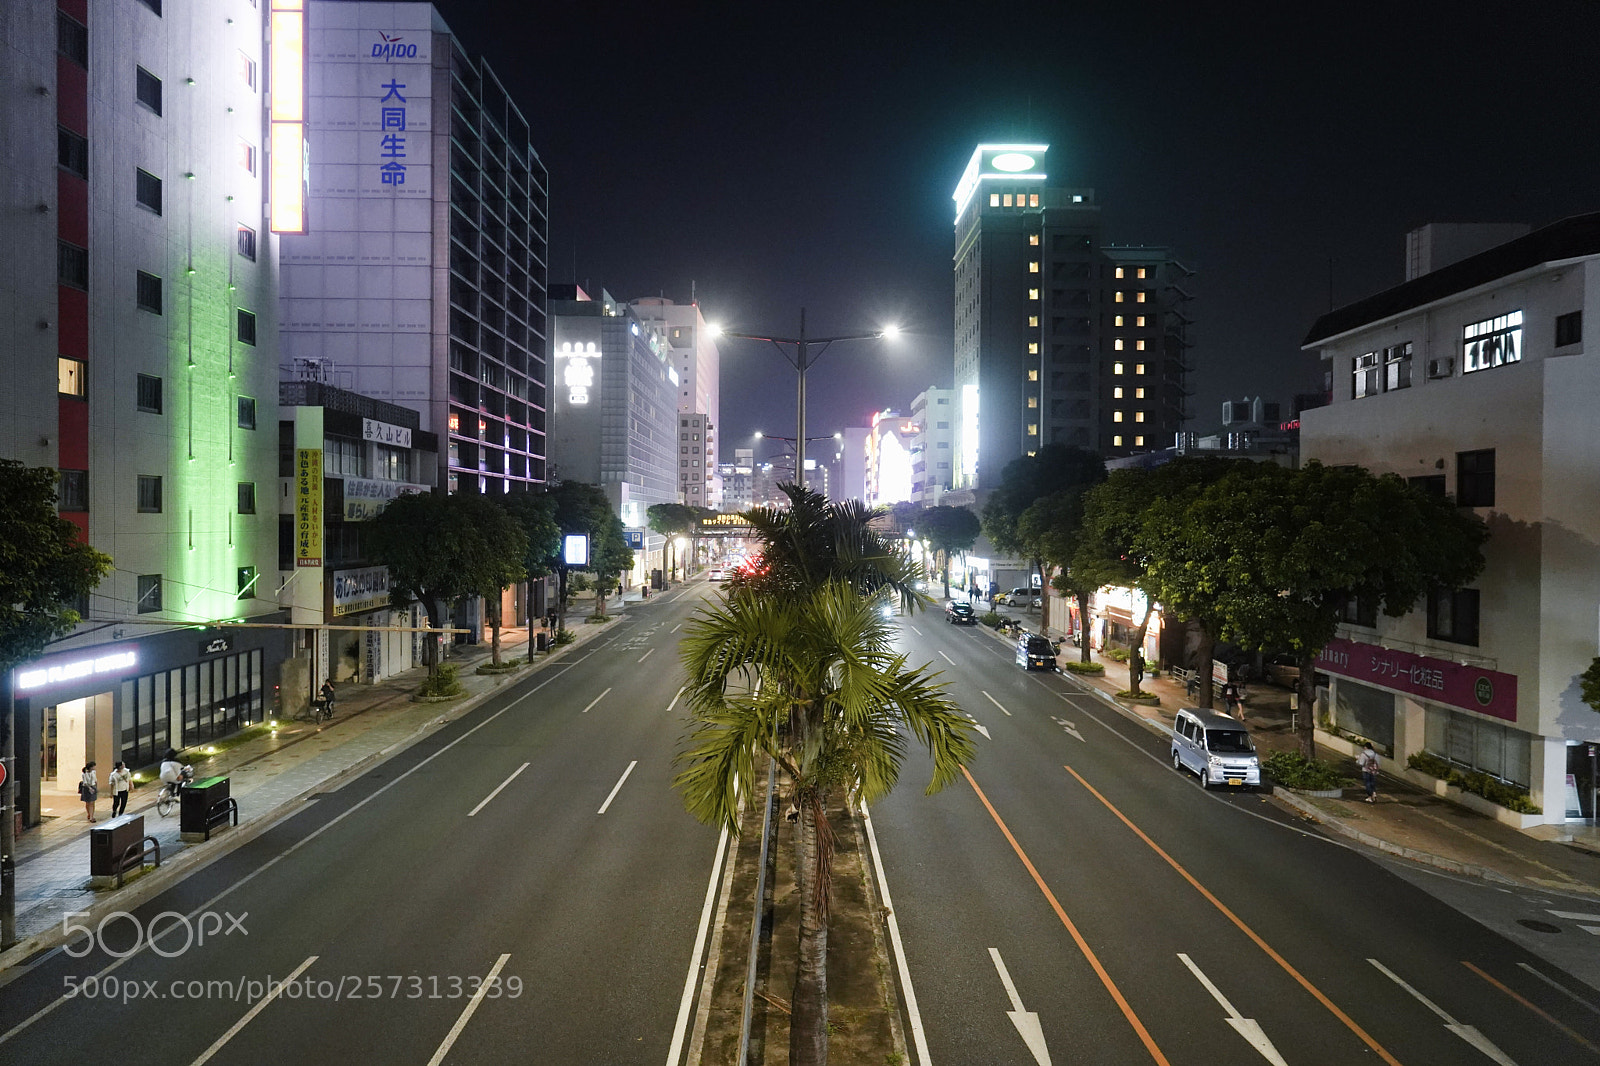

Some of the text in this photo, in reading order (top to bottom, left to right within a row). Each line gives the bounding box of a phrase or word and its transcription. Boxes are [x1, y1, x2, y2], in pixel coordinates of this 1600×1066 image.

[371, 43, 417, 62] DAIDO
[380, 79, 407, 187] 大同生命
[364, 420, 411, 447] 喜久山ビル
[1370, 656, 1444, 690] シナリー化粧品
